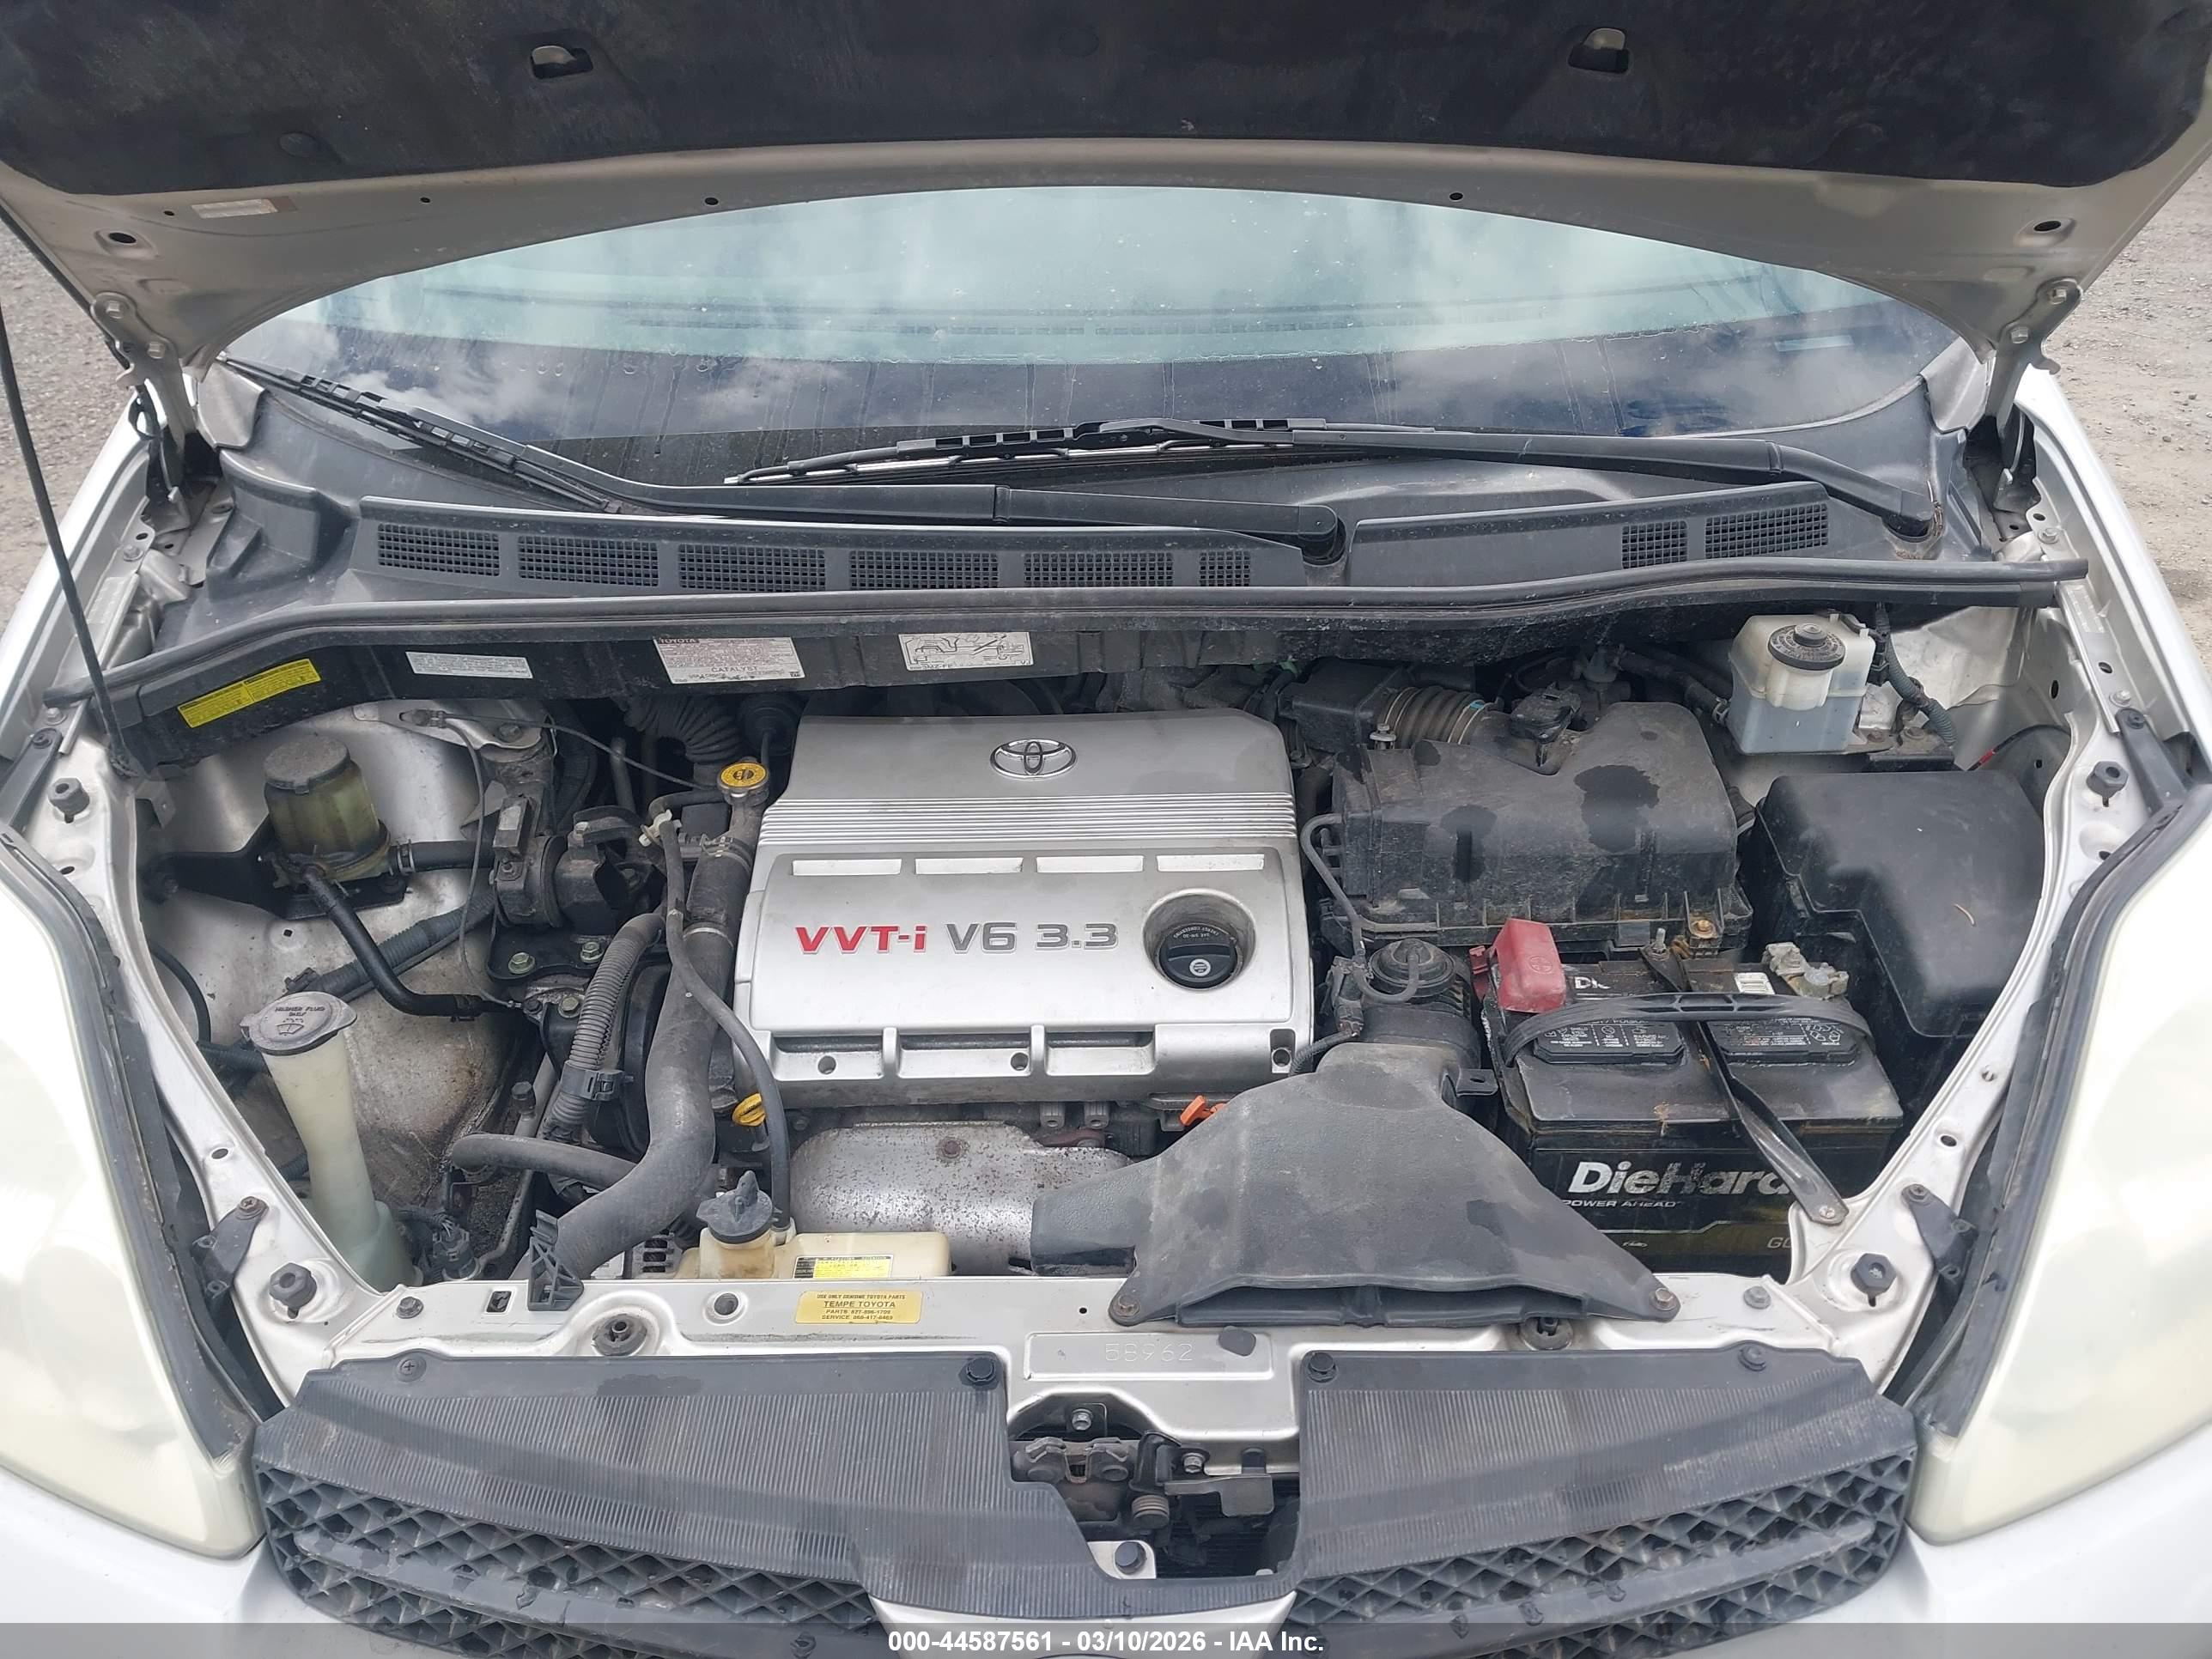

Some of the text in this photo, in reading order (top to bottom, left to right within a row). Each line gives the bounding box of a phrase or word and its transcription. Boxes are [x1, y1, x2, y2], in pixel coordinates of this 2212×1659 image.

[795, 922, 1118, 954] VVT-i V6 3.3
